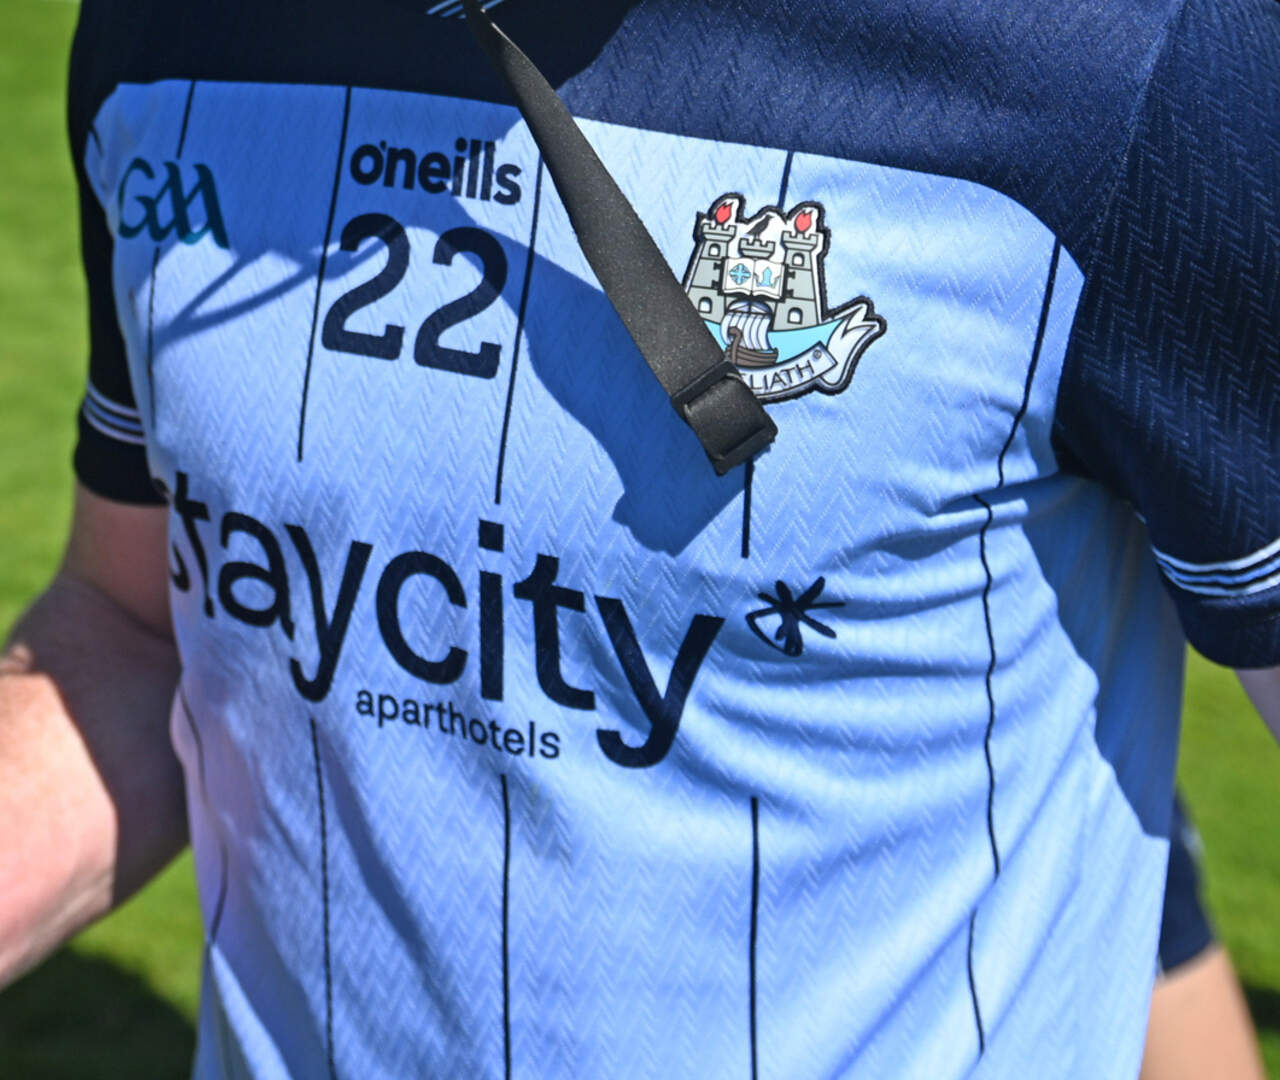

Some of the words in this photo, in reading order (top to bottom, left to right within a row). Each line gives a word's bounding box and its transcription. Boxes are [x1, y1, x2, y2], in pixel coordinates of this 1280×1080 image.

[118, 157, 231, 251] GAA
[321, 213, 508, 380] 22
[743, 359, 816, 392] LIATH
[356, 689, 561, 760] aparthotels
